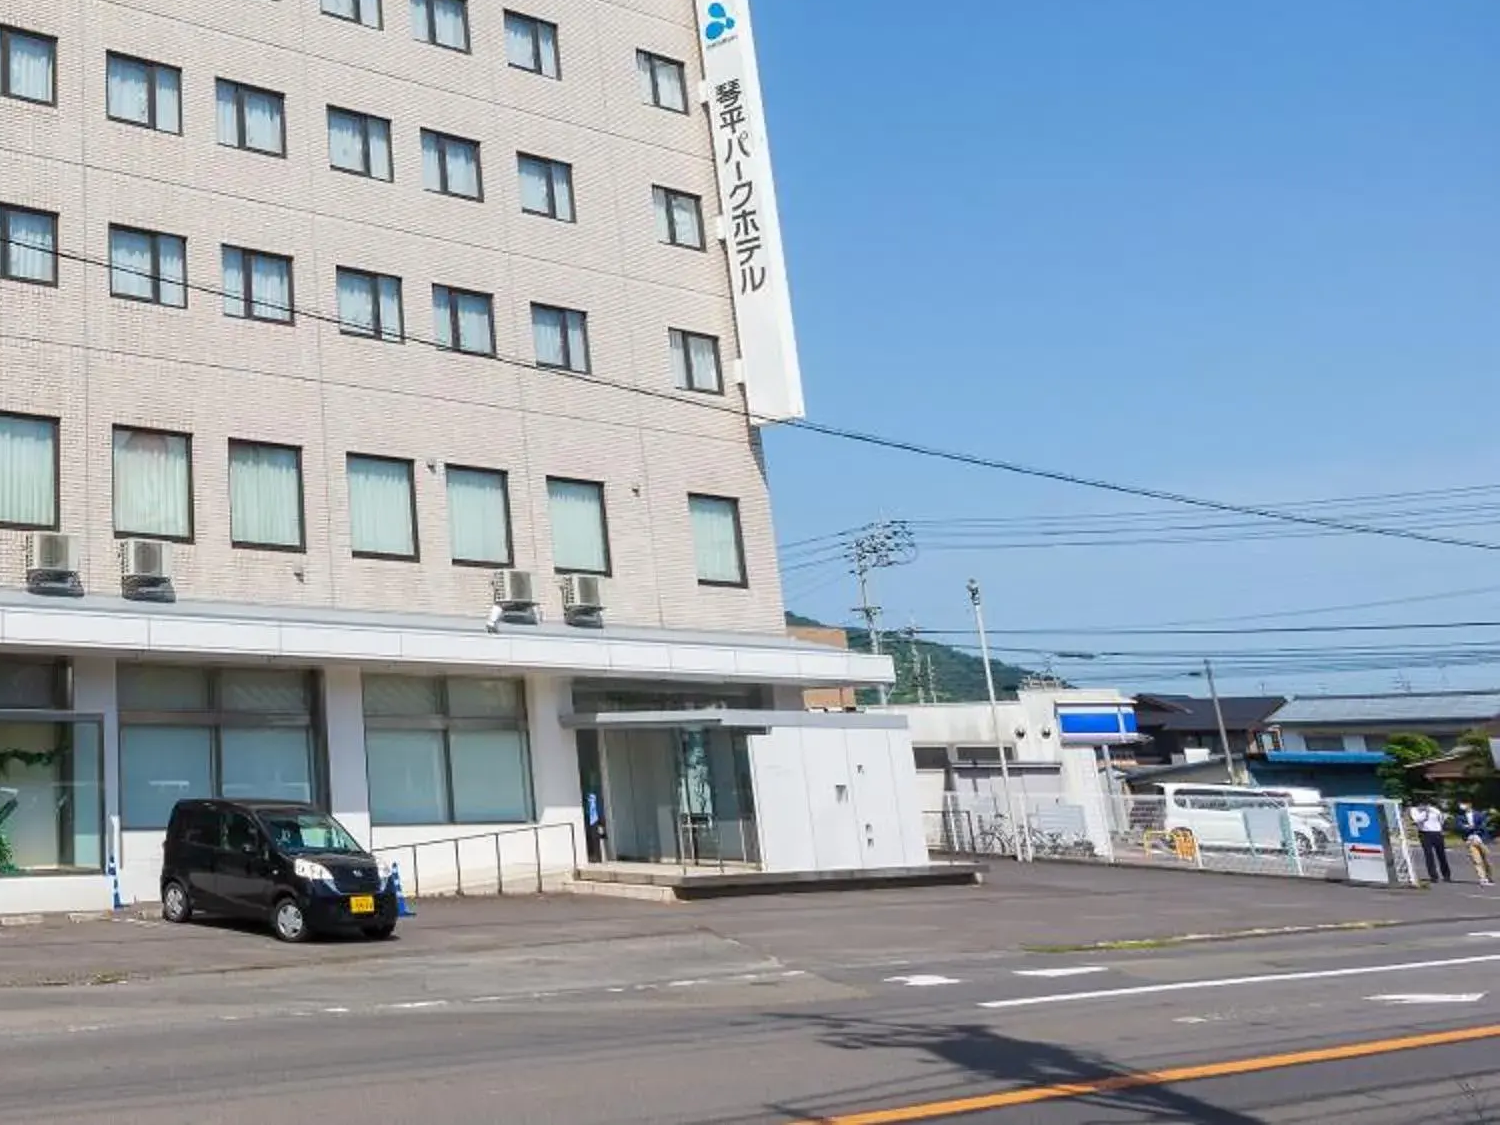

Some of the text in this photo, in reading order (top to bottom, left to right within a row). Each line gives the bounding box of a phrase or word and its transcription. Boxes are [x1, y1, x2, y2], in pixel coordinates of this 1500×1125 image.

[714, 78, 766, 295] 琴平パークホテル
[1348, 811, 1371, 837] P
